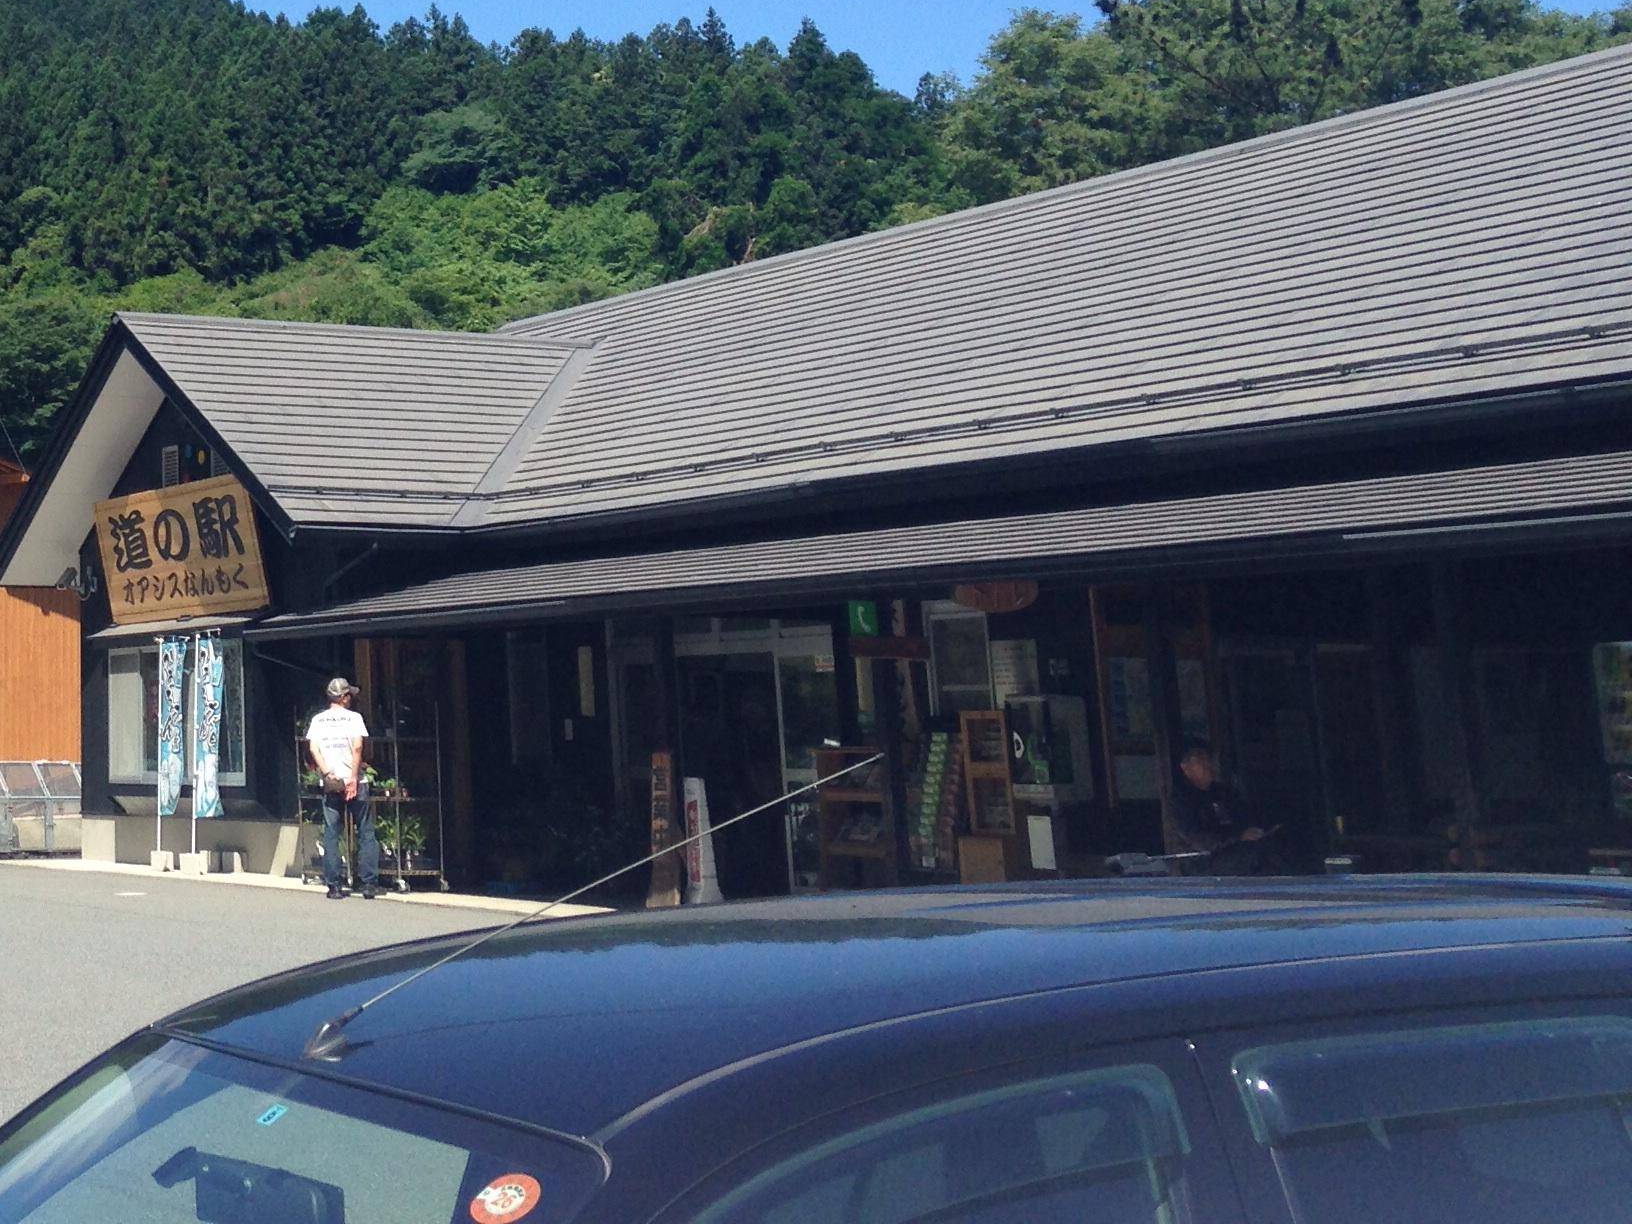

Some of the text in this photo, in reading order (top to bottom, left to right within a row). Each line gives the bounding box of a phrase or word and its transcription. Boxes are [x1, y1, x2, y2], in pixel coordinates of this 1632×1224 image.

[108, 494, 245, 573] 道の駅
[123, 562, 249, 605] オアシスなんもく
